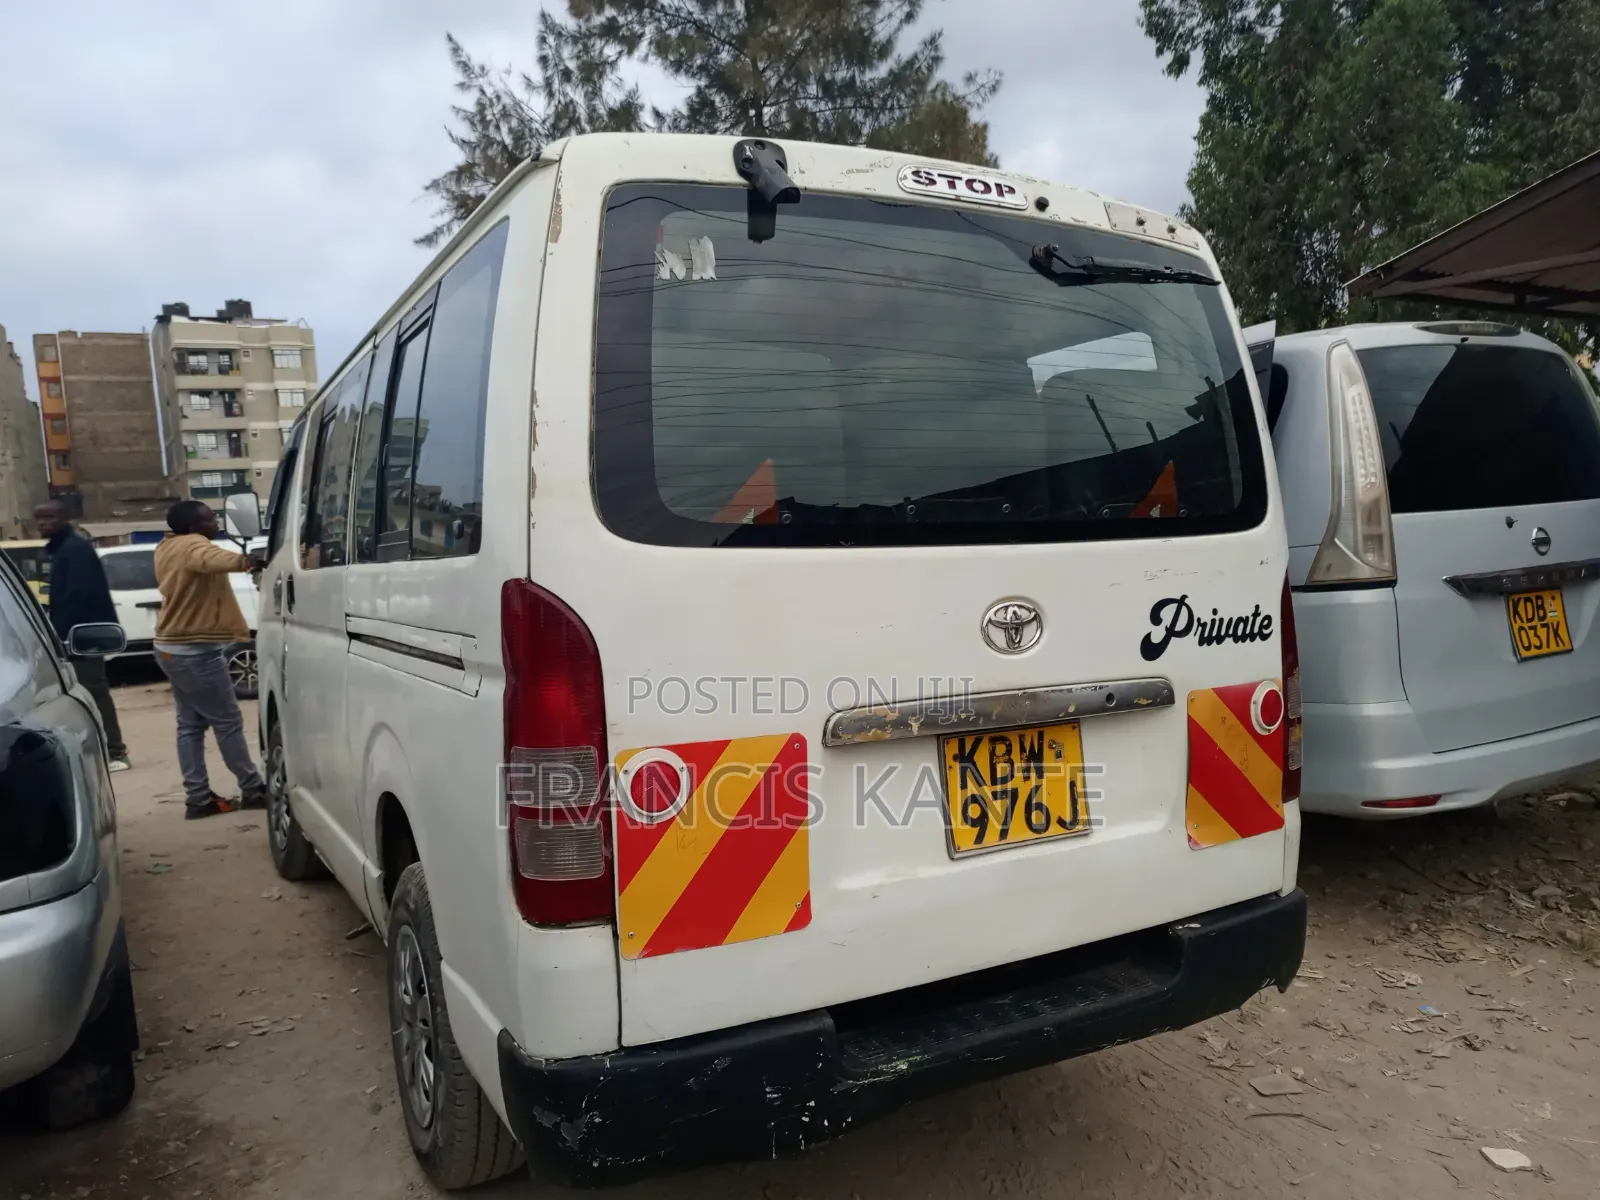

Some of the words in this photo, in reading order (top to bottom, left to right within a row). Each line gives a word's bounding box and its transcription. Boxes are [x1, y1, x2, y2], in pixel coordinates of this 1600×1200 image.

[911, 170, 1016, 198] STOP
[1140, 594, 1273, 661] Private
[1511, 595, 1547, 624] KDB
[1517, 621, 1566, 652] 037K
[957, 730, 1045, 790] KBW
[961, 780, 1080, 845] 976J
